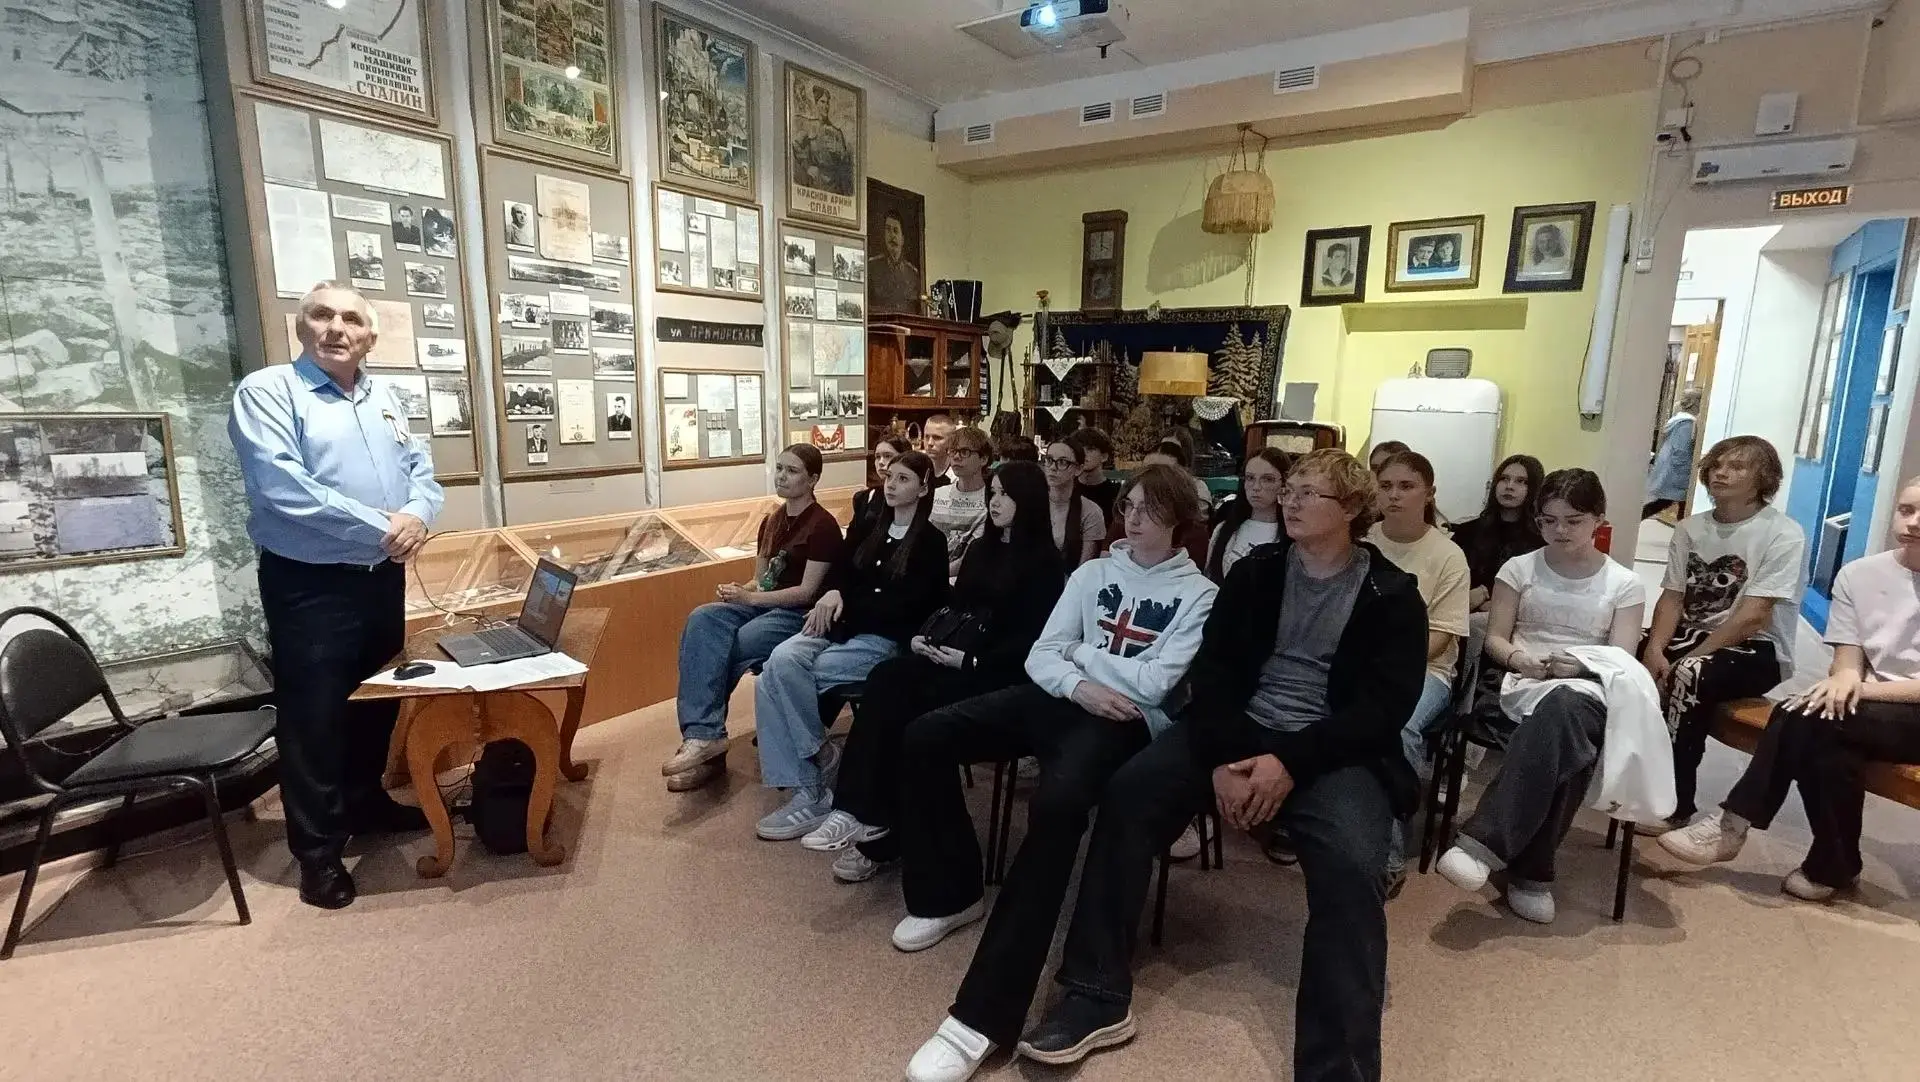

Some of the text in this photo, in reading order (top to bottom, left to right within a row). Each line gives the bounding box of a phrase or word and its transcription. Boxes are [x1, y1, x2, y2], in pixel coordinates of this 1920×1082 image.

[353, 60, 412, 84] ЛОКОМОТИВА
[364, 54, 418, 77] МАШИНИСТ
[365, 73, 420, 94] РЕВОЛЮЦИИ
[356, 80, 423, 110] СТАЛИН
[830, 194, 853, 208] АРМИИ
[1780, 189, 1842, 207] ВЫХОД
[810, 201, 841, 217] СЛАВА!
[690, 325, 757, 342] ПРИМОРСКАЯ
